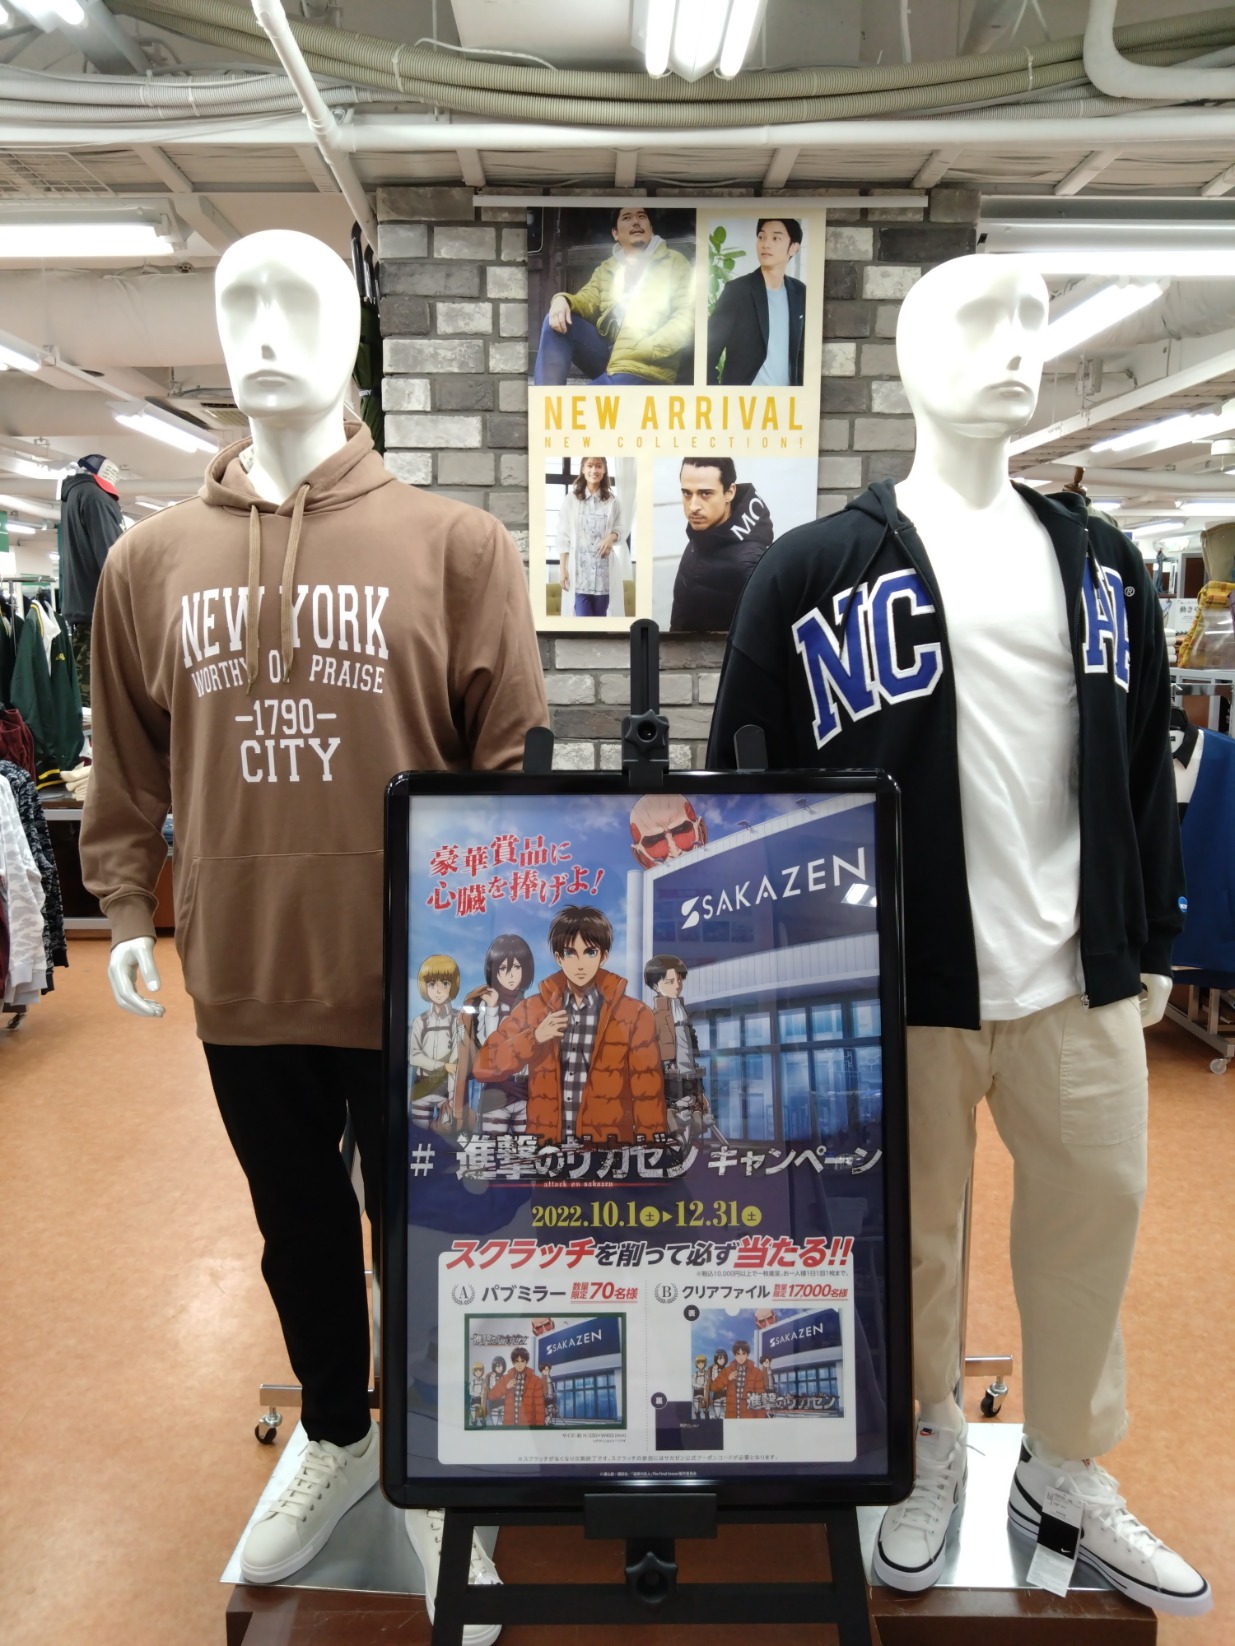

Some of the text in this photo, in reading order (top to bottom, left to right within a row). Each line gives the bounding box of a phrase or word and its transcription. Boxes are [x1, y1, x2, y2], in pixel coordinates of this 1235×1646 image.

[544, 395, 803, 431] NEW ARRIVAL
[545, 436, 803, 449] NEW COLLECTION!
[181, 584, 390, 669] NEW YORK
[268, 650, 290, 684] O
[308, 654, 385, 694] PRAISE
[240, 737, 341, 783] CITY
[430, 834, 573, 877] 豪華賞品に
[702, 847, 866, 920] SAKAZEN
[481, 1284, 566, 1303] パブミラー
[682, 1285, 770, 1300] クリアファイル
[552, 1329, 602, 1353] SAKAZEN
[775, 1323, 824, 1345] SAKAZEN
